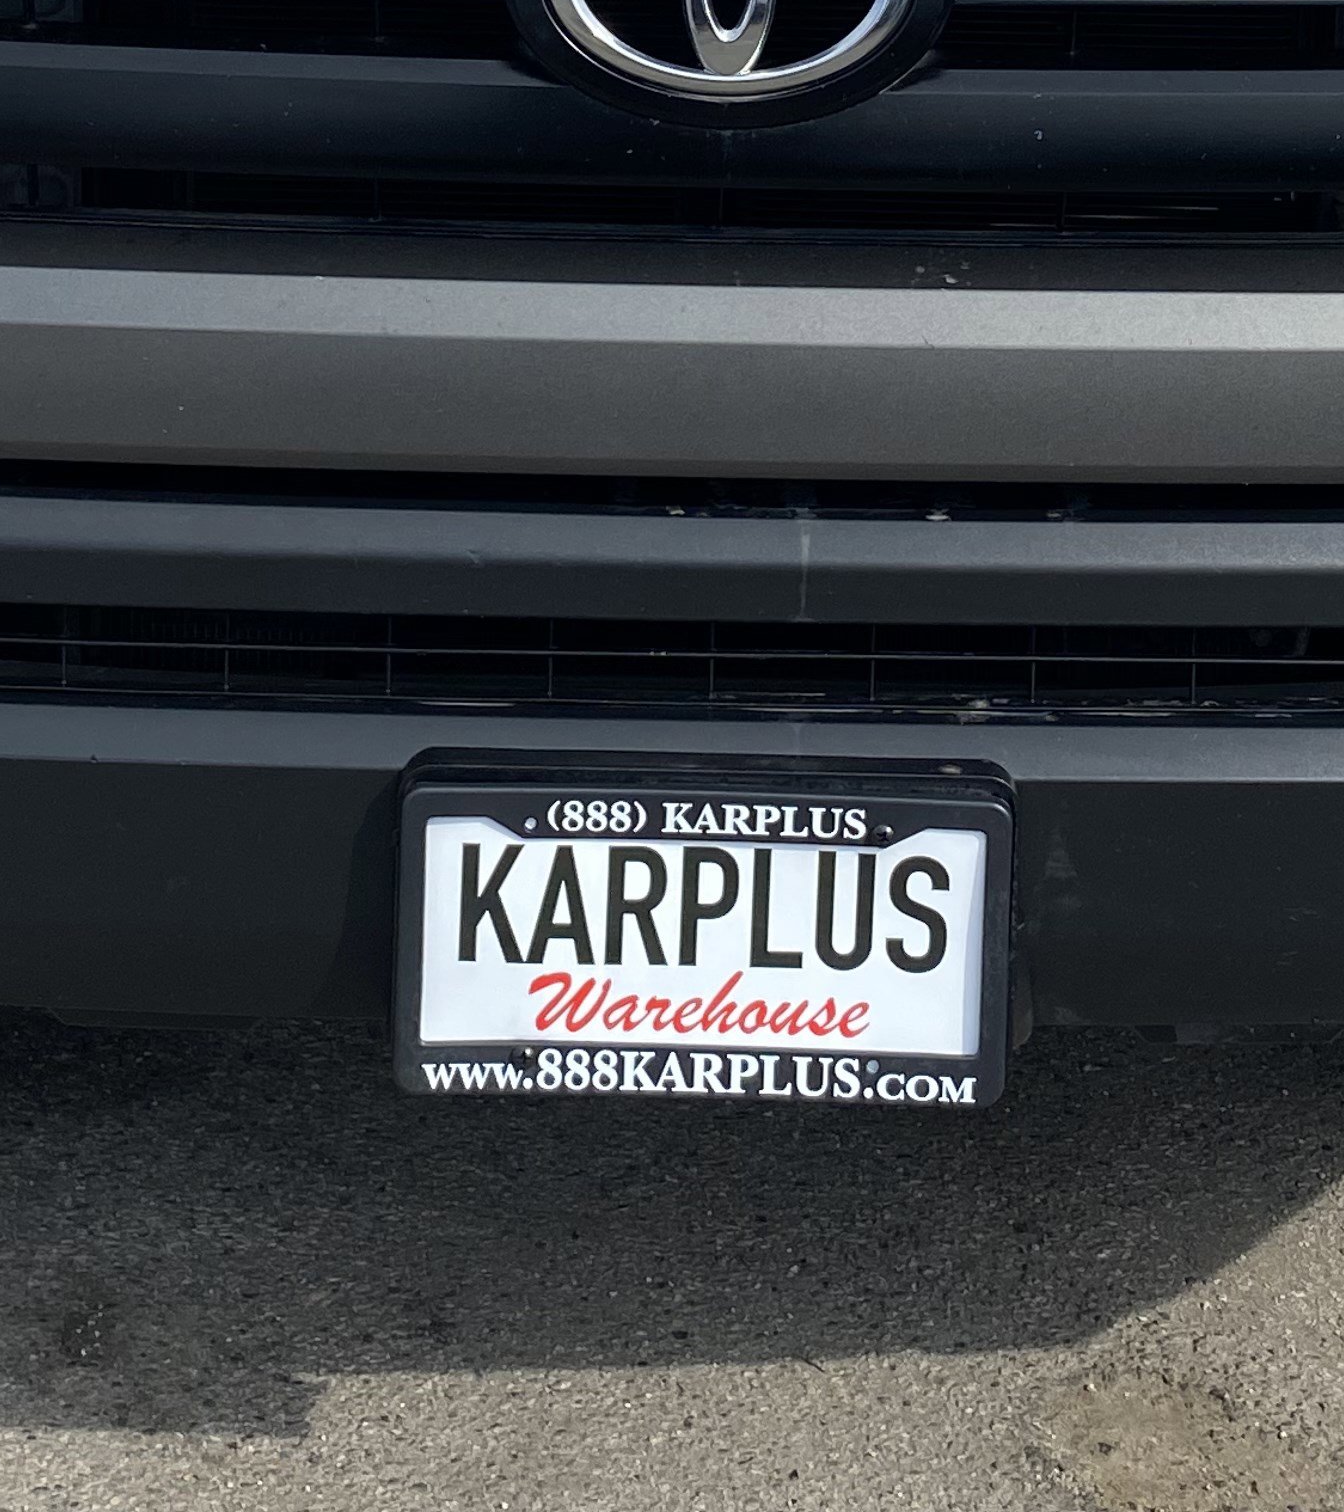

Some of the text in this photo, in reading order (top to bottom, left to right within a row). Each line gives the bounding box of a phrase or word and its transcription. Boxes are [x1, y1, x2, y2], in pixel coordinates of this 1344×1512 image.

[546, 800, 868, 840] (888) KARPLUS
[457, 843, 951, 974] KARPLUS
[528, 970, 871, 1039] Warehouse
